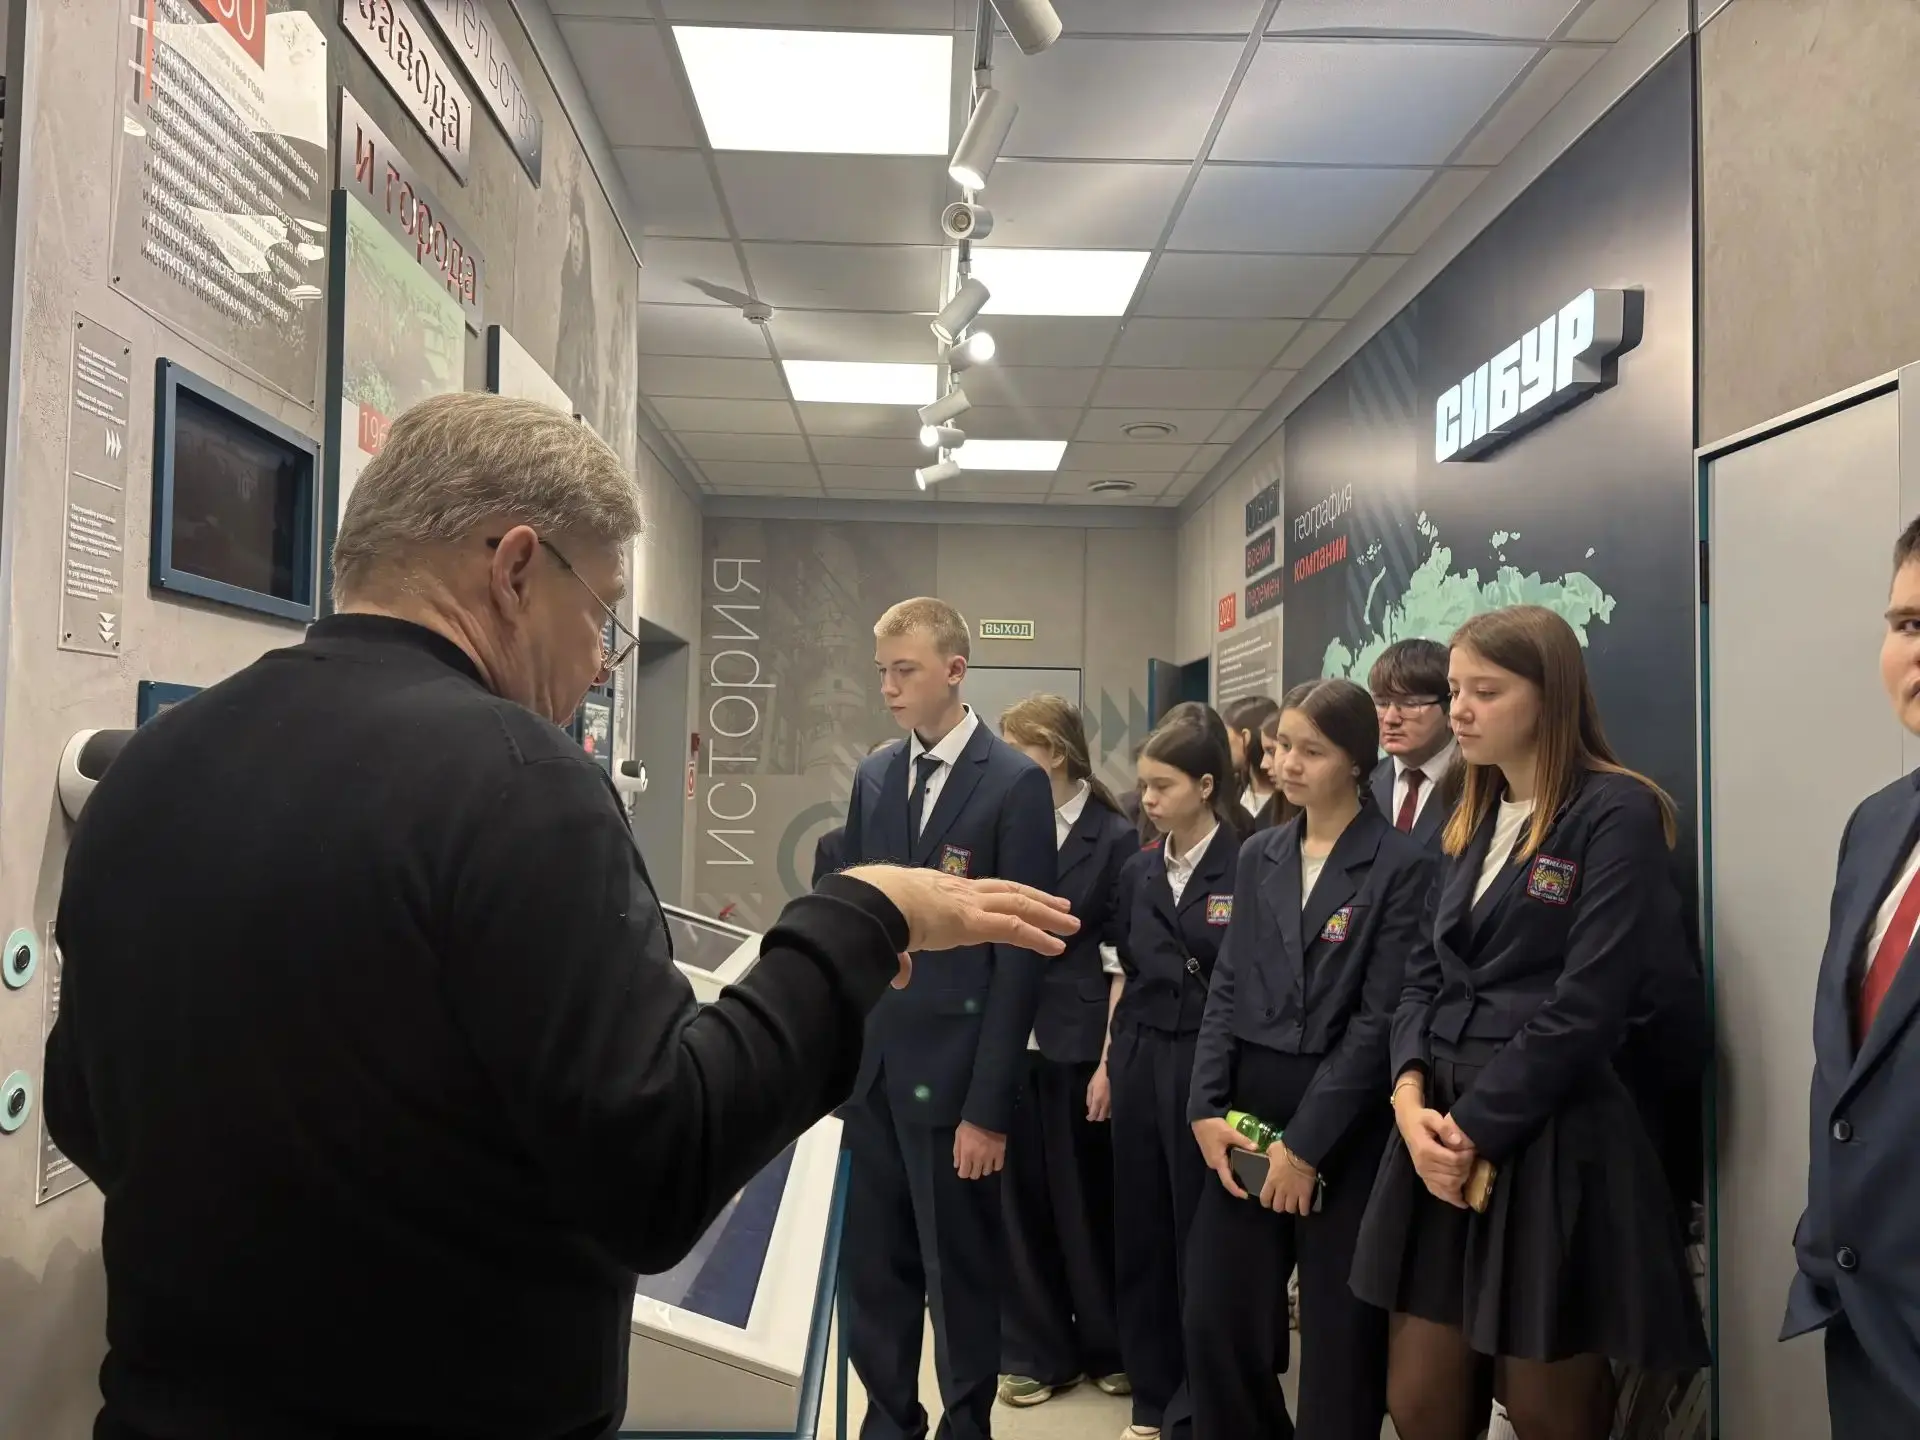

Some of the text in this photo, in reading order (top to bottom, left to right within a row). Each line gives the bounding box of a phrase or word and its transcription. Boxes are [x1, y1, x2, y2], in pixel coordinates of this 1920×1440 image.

[158, 68, 226, 144] СТРОИТЕЛЬНЫМИ
[159, 40, 238, 130] САННО-ТРАКТОРНЫЙ
[239, 119, 261, 153] ПОЕЗД
[260, 140, 266, 156] С
[155, 124, 196, 171] ПЕРВЫМИ
[196, 159, 208, 181] НА
[208, 169, 233, 203] МЕСТО
[156, 92, 216, 163] ПЕРЕДВИЖНОЙ
[216, 147, 258, 200] КОТЕЛЬНОЙ,
[287, 142, 318, 187] ПОДЪЕХАЛ
[150, 181, 158, 199] И
[158, 187, 201, 232] РАБОТАЛИ
[153, 151, 160, 170] И
[160, 156, 224, 222] МИКРОРАЙОНОВ
[355, 122, 477, 306] и города
[146, 237, 196, 283] ИНСТИТУТА
[148, 209, 288, 324] И ТОПОГРАФЫ, ЭКСПЕДИЦИЯ СОЮЗНОГО
[1436, 287, 1595, 464] СИБУР
[1294, 482, 1353, 543] география
[1246, 538, 1271, 568] время
[1294, 534, 1348, 584] компании
[1246, 575, 1280, 611] перемен
[985, 623, 1029, 635] ВЫХОД
[706, 558, 777, 866] история
